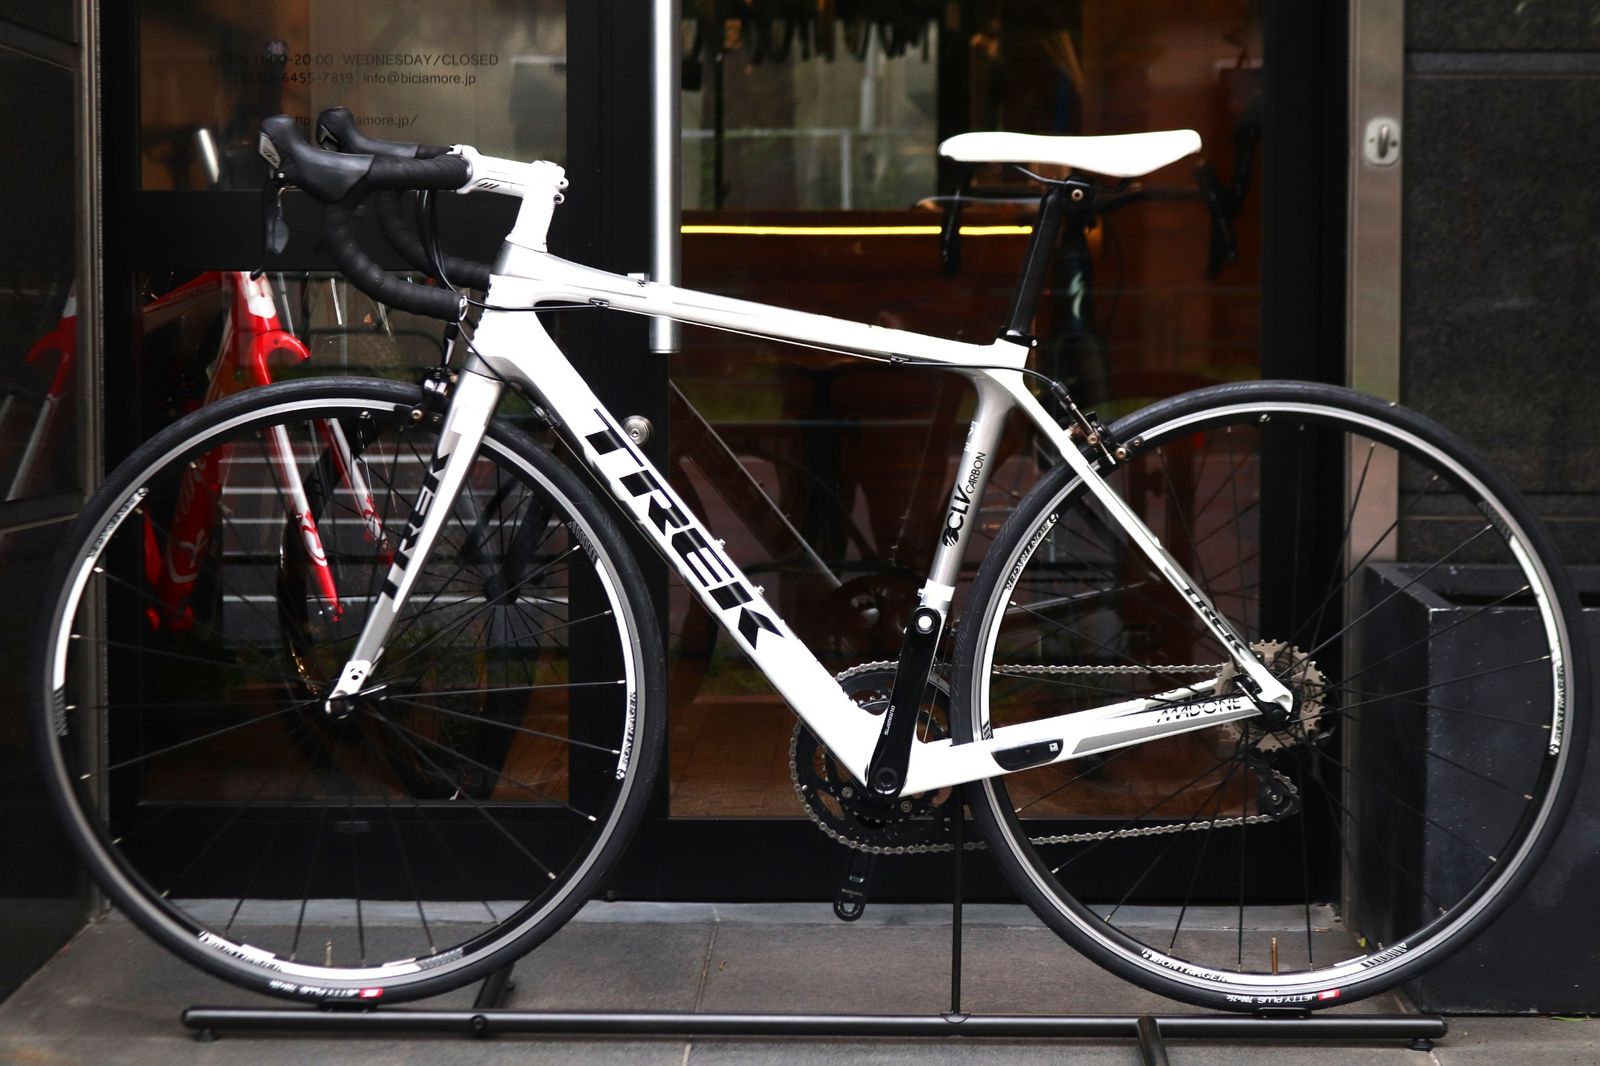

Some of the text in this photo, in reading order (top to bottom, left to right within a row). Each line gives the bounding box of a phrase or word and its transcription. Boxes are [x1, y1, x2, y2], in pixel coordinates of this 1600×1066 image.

[208, 54, 249, 65] OPEN
[343, 54, 499, 66] WEDNESDAY/CLOSED
[363, 71, 477, 86] info@biciamore.jp
[965, 452, 986, 494] CARBON
[380, 448, 450, 600] TREK
[585, 408, 785, 650] TREK
[1005, 522, 1049, 591] BONTRAGER
[1185, 583, 1245, 653] TREK
[622, 691, 637, 766] BONTRAGER
[1157, 698, 1241, 722] MADONE
[1154, 957, 1226, 983] BONTRAGER
